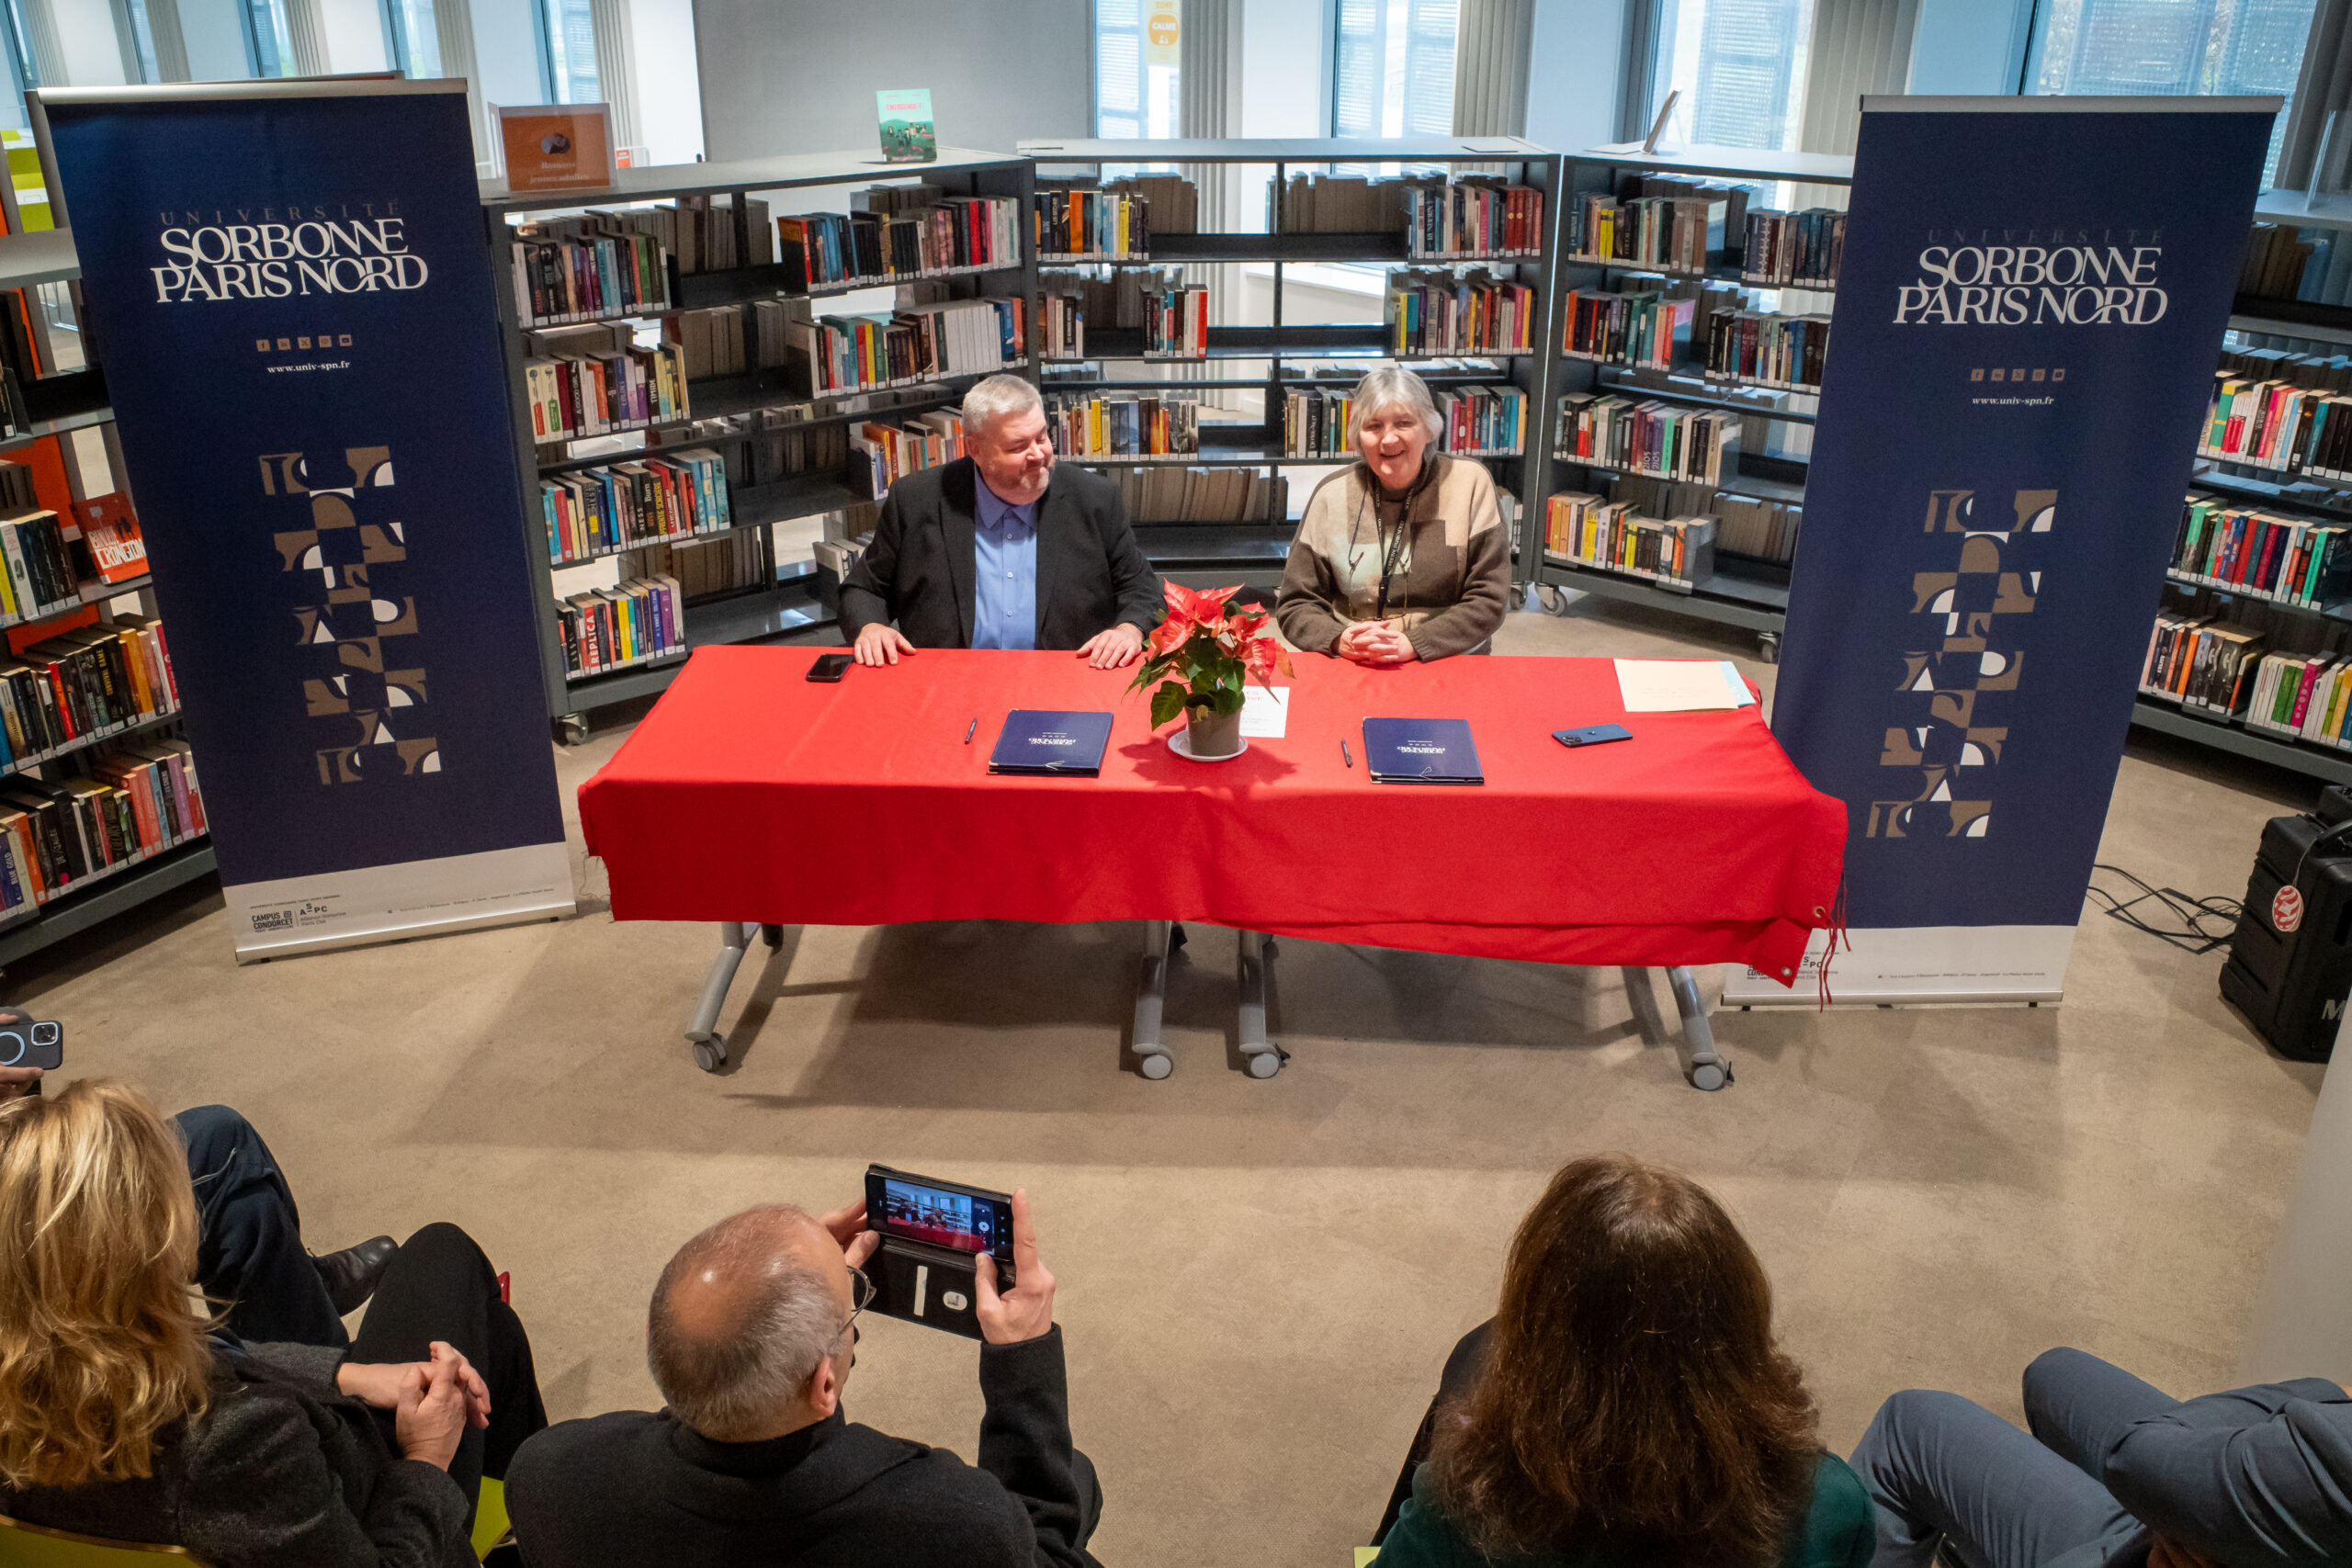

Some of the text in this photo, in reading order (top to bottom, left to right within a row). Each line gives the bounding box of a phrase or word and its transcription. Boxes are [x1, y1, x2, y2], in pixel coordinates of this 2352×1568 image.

[1152, 22, 1177, 30] CALME
[161, 199, 401, 226] UNIVERSITÉ
[161, 218, 409, 270] SORBONNE
[1928, 226, 2165, 243] UNIVERSITÉ
[150, 254, 429, 303] PARIS NORD
[1917, 246, 2162, 290] SORBONNE
[1893, 286, 2168, 325] PARIS NORD
[267, 360, 351, 374] www.univ-spn.fr
[650, 378, 659, 404] TIMIDE
[1972, 396, 2054, 407] www.univ-spn.fr
[644, 482, 652, 503] Burn
[586, 615, 600, 665] REPLICA
[96, 649, 114, 696] SURVIVAL GAME
[5, 852, 19, 886] BLUE GOLD
[252, 912, 281, 922] CAMPUS
[253, 918, 293, 930] CONDORCET
